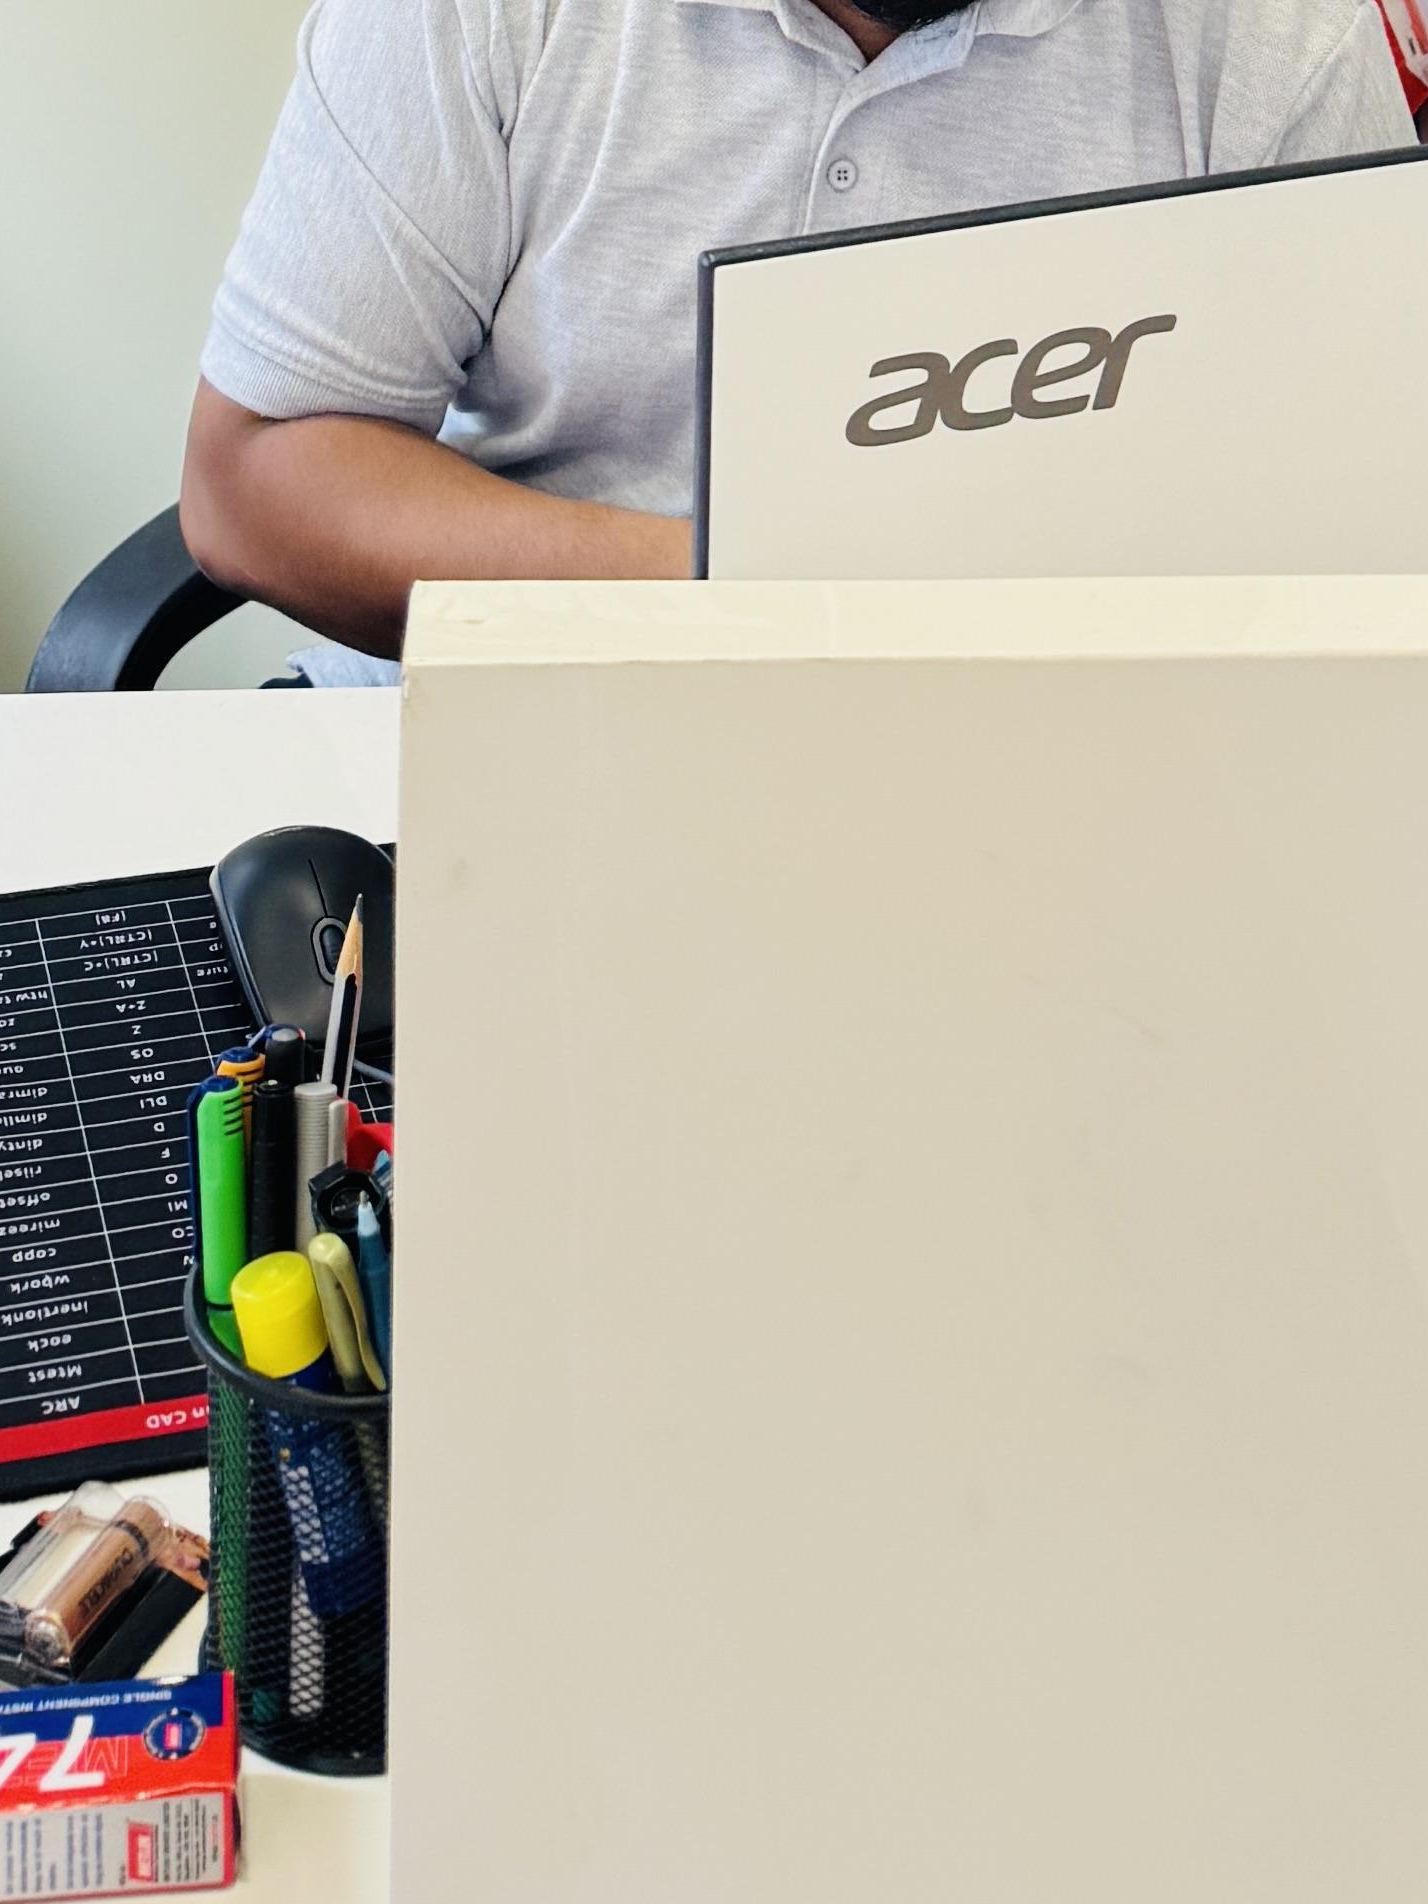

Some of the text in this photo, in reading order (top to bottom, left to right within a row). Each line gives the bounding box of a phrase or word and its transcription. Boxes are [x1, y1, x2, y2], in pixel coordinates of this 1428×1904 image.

[846, 315, 1176, 446] acer
[130, 1071, 164, 1084] DRA
[41, 1396, 80, 1414] ARC
[146, 1410, 185, 1429] CAD
